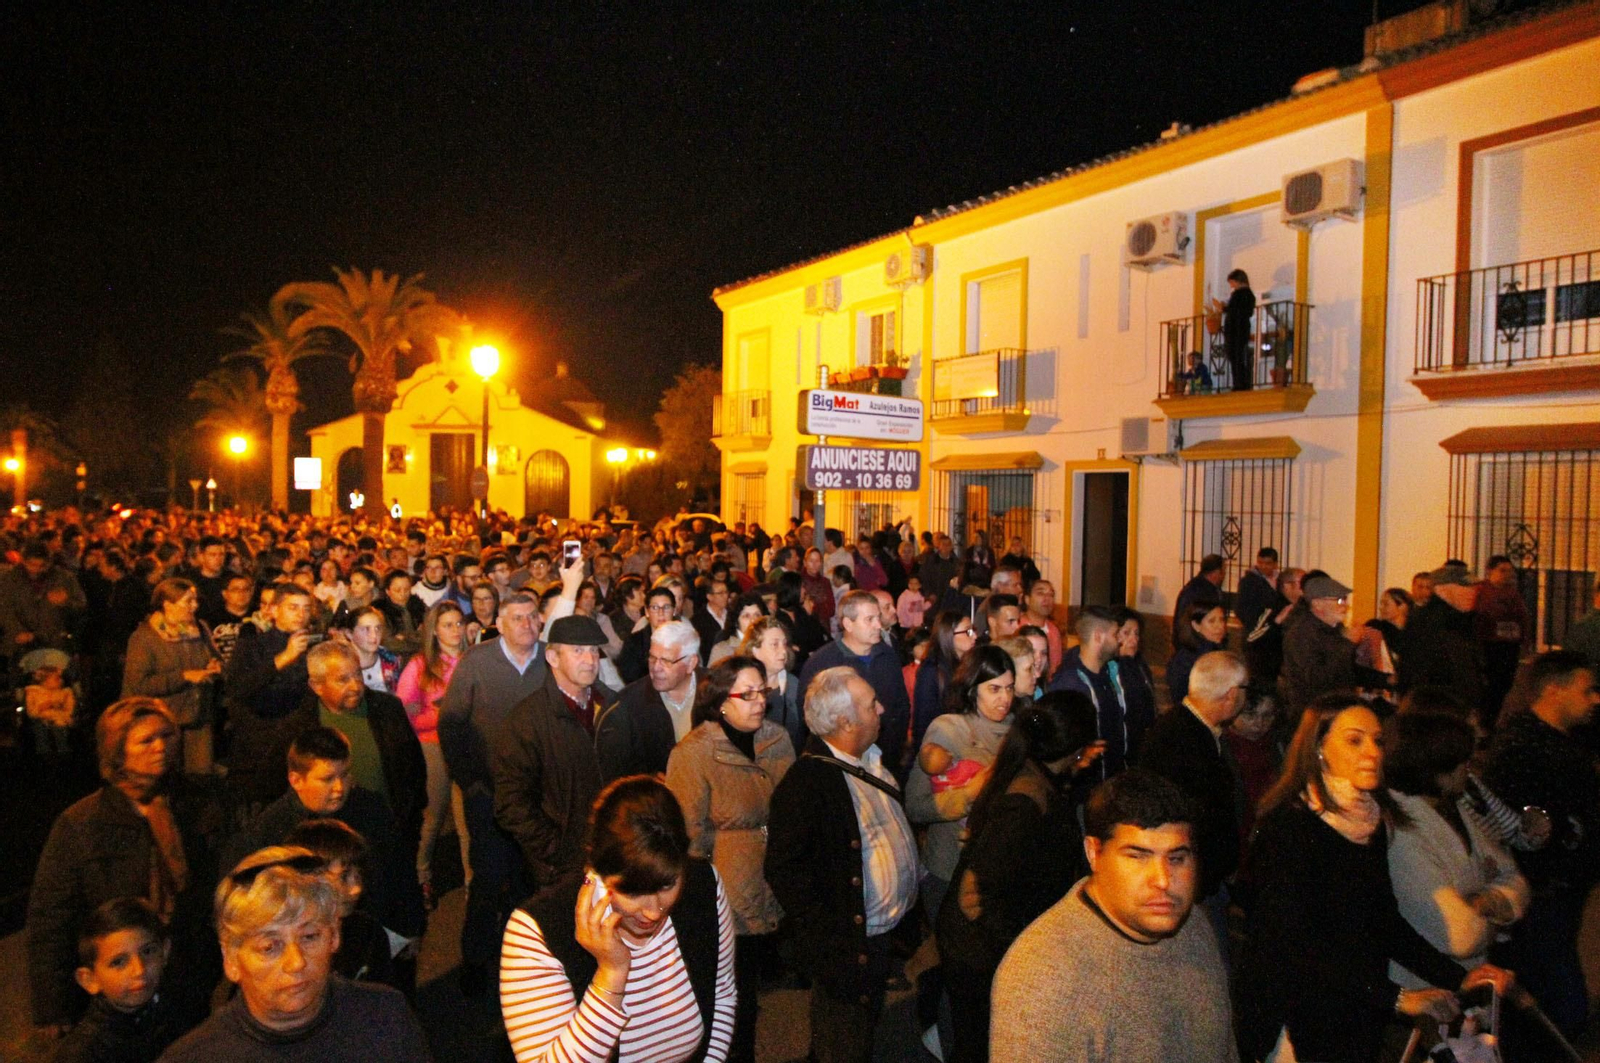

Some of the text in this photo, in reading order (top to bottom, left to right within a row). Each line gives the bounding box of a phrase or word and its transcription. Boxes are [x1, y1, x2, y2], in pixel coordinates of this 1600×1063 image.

[812, 394, 859, 411] BigMat
[869, 401, 920, 414] Azulejos Ramos
[811, 447, 917, 472] ANUNCIESE AQUI
[815, 471, 842, 488] 902
[855, 472, 872, 488] 10
[875, 473, 893, 489] 36
[895, 474, 912, 489] 69
